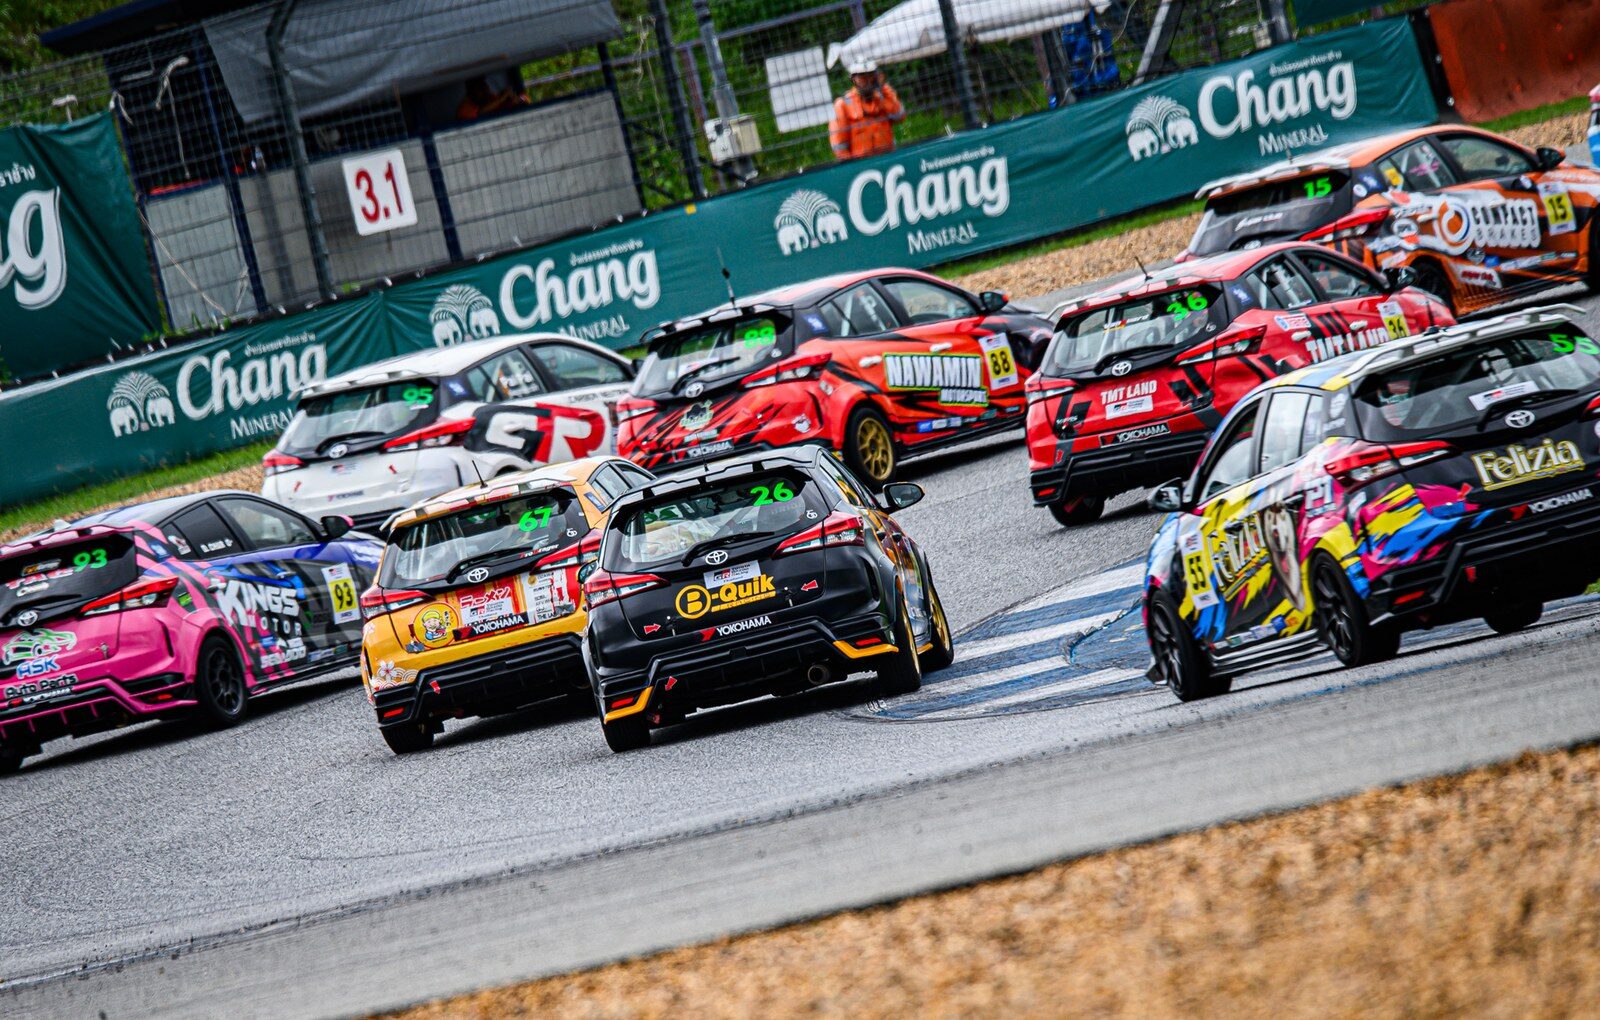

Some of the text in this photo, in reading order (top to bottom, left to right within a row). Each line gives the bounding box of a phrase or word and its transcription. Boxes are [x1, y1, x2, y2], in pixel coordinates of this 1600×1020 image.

[1198, 60, 1357, 139] Chang
[354, 159, 404, 224] 3.1
[848, 156, 1010, 236] Chang
[1304, 177, 1331, 200] 15
[1471, 203, 1536, 225] COMPACT
[1548, 196, 1568, 222] 15
[500, 250, 661, 330] Chang
[1166, 290, 1208, 321] 36
[745, 326, 776, 348] 88
[1549, 333, 1600, 355] 55
[885, 356, 982, 388] NAWAMIN
[990, 351, 1011, 375] 88
[176, 342, 328, 421] Chang
[1101, 379, 1157, 404] TMT LAND
[403, 388, 433, 405] 95
[1117, 424, 1168, 443] YOKOHAMA
[1472, 438, 1580, 484] Felizia
[750, 481, 794, 507] 26
[1528, 488, 1593, 513] YOKOHAMA
[518, 508, 551, 532] 67
[73, 549, 108, 572] 93
[1188, 554, 1207, 591] 55
[216, 579, 300, 627] KINGS
[334, 582, 354, 609] 93
[460, 586, 511, 608] ラーメン
[678, 574, 775, 617] B-Quik
[473, 615, 524, 635] YOKOHAMA
[717, 616, 772, 636] YOKOHAMA
[17, 655, 58, 678] ASK
[6, 675, 77, 697] Auto Parts
